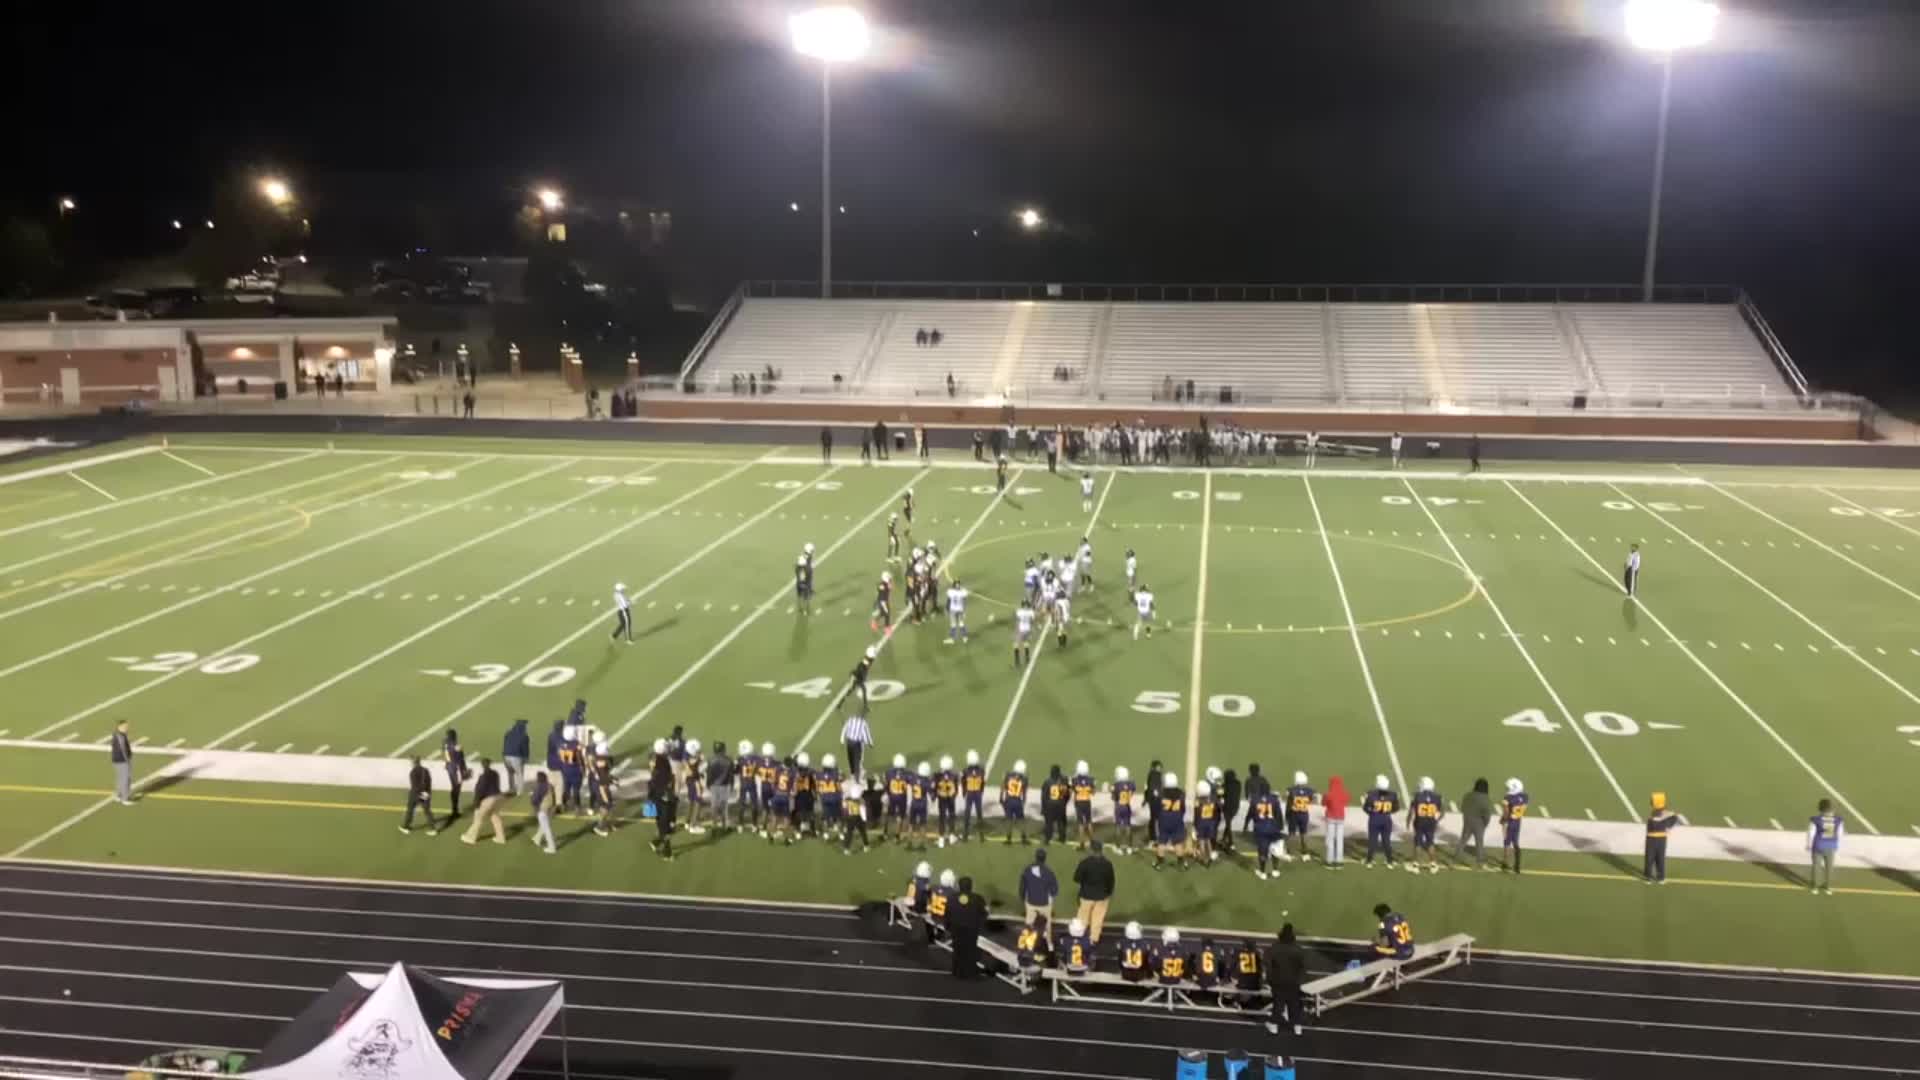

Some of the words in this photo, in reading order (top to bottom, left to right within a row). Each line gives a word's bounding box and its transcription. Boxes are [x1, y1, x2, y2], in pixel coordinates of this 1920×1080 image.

[127, 651, 260, 674] 20
[453, 663, 577, 687] 30
[780, 676, 906, 701] 40
[1131, 690, 1256, 717] 50
[1502, 708, 1640, 736] 40
[1202, 951, 1215, 973] 6
[1239, 951, 1257, 973] 21
